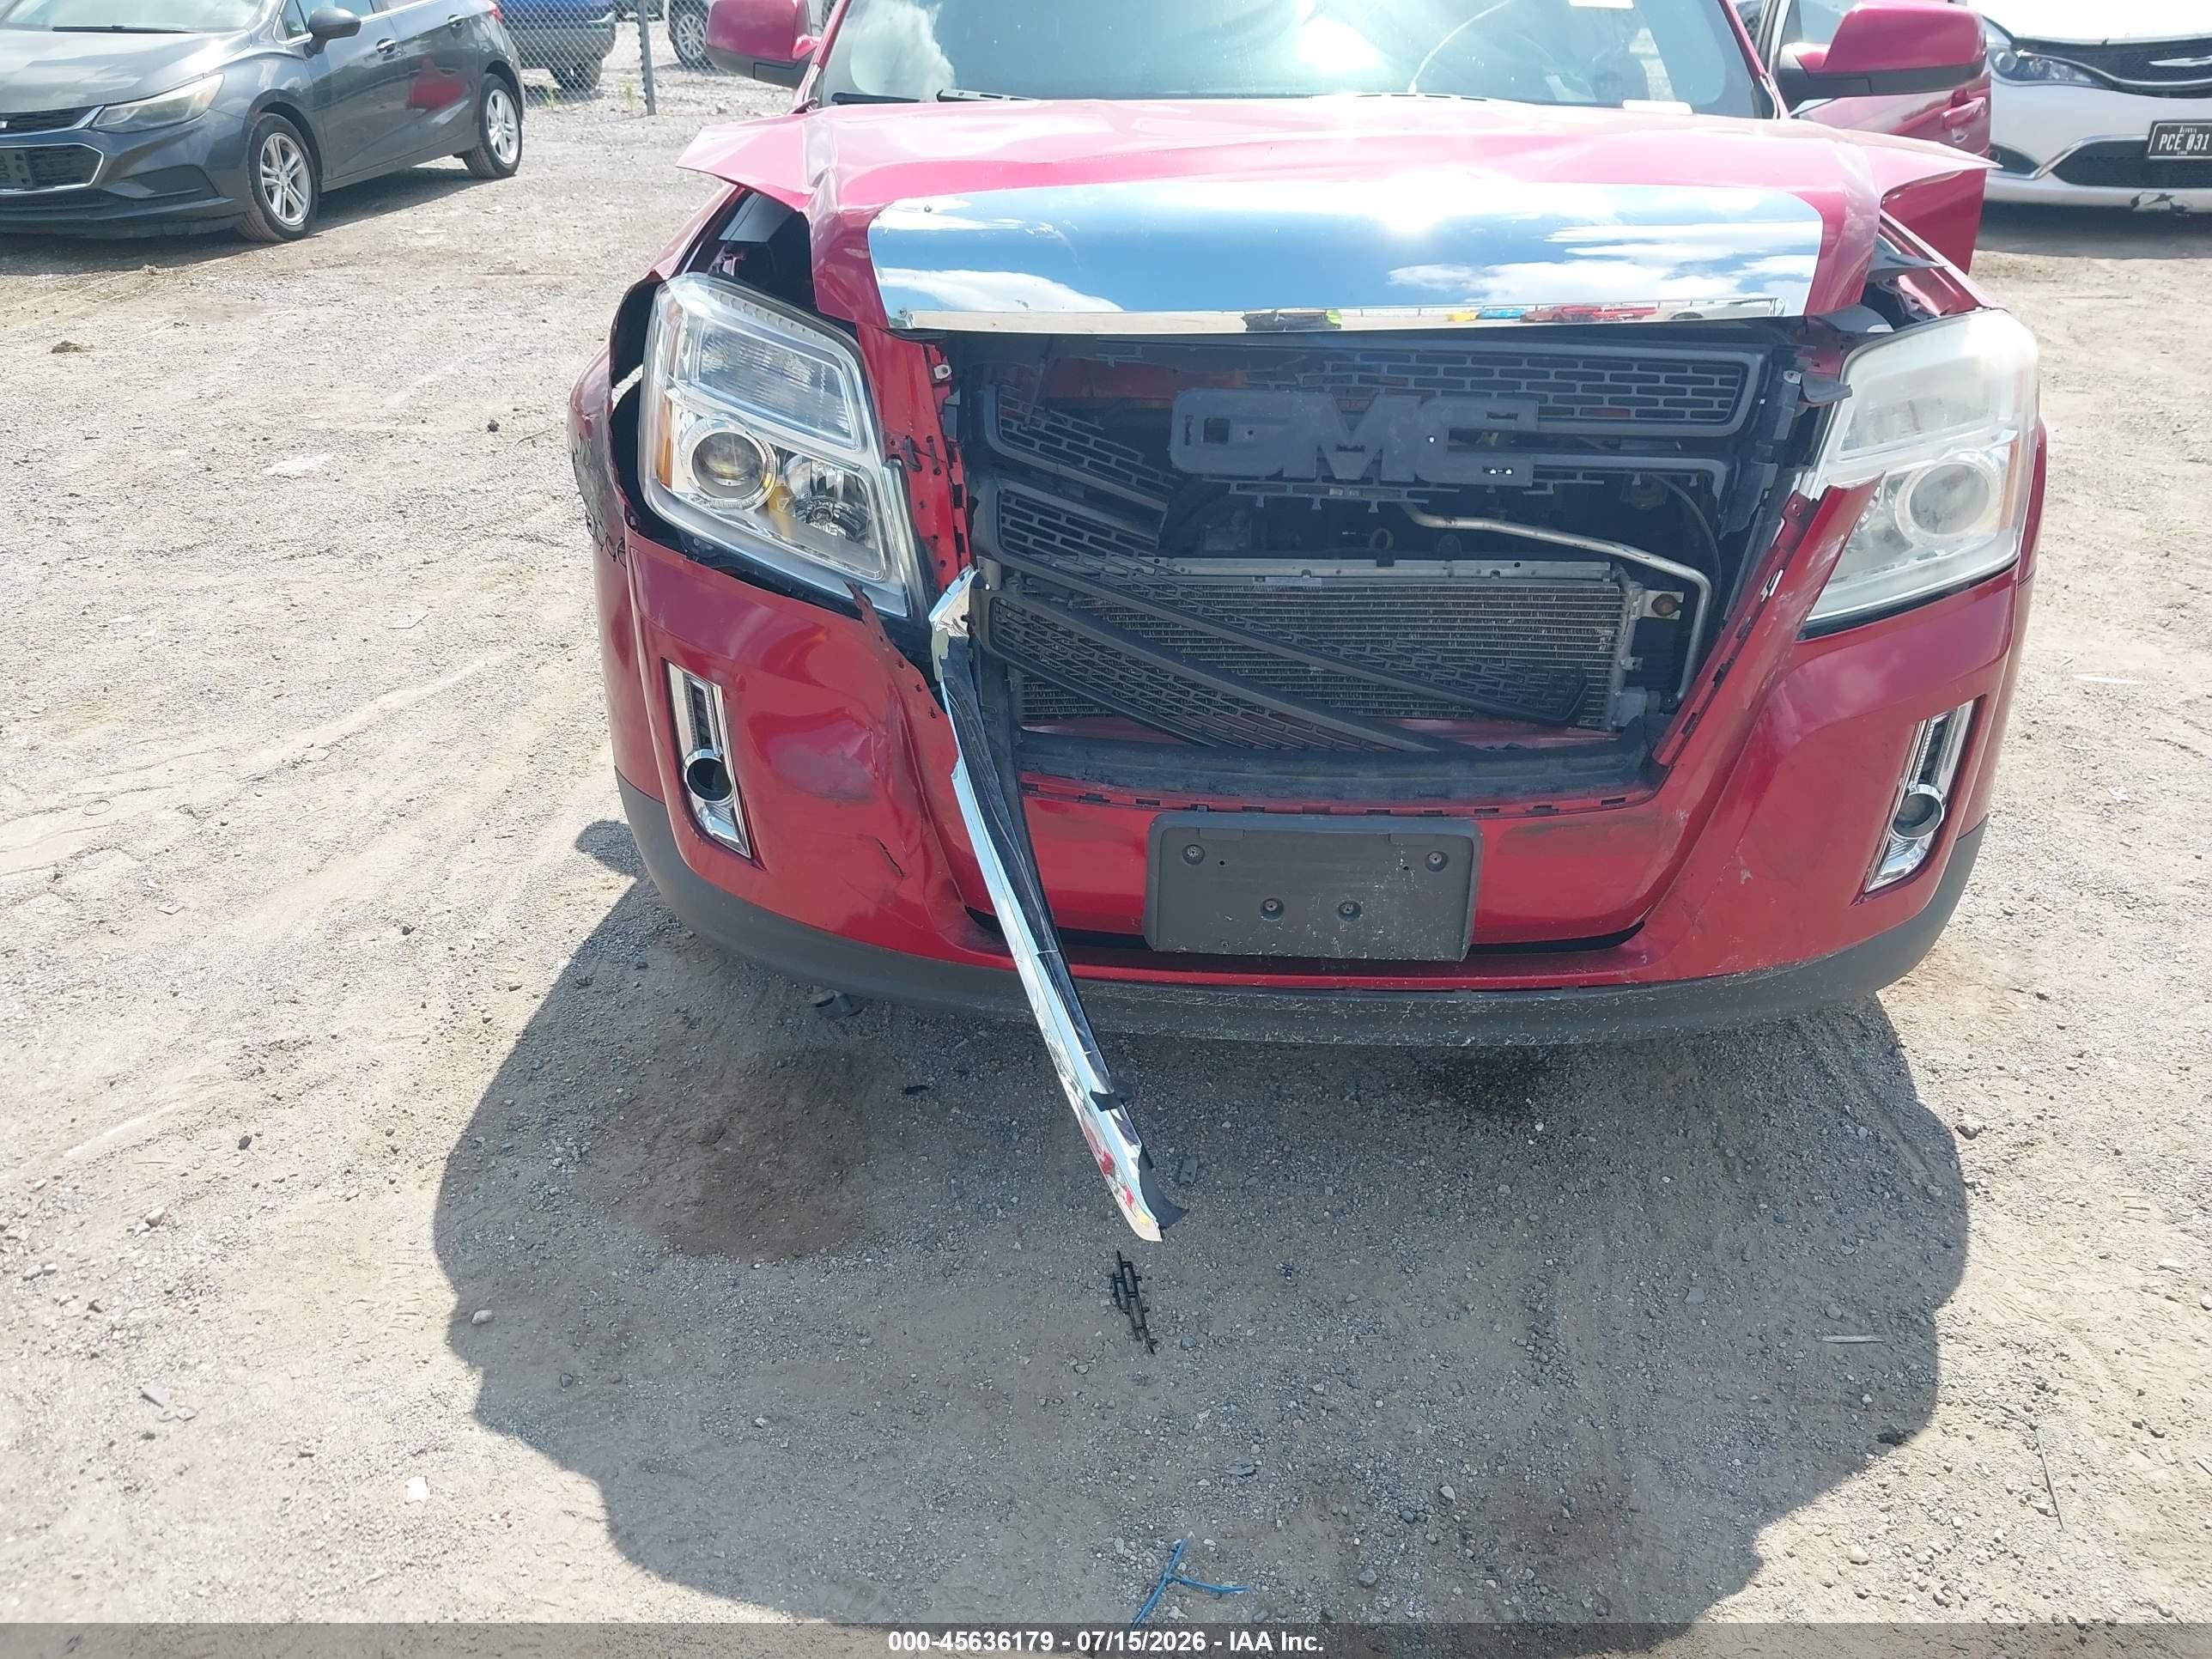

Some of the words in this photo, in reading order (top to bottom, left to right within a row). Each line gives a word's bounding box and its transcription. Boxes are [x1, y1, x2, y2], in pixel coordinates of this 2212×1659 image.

[2158, 133, 2185, 151] PCE
[2185, 133, 2210, 151] 031
[1170, 388, 1539, 488] GMC
